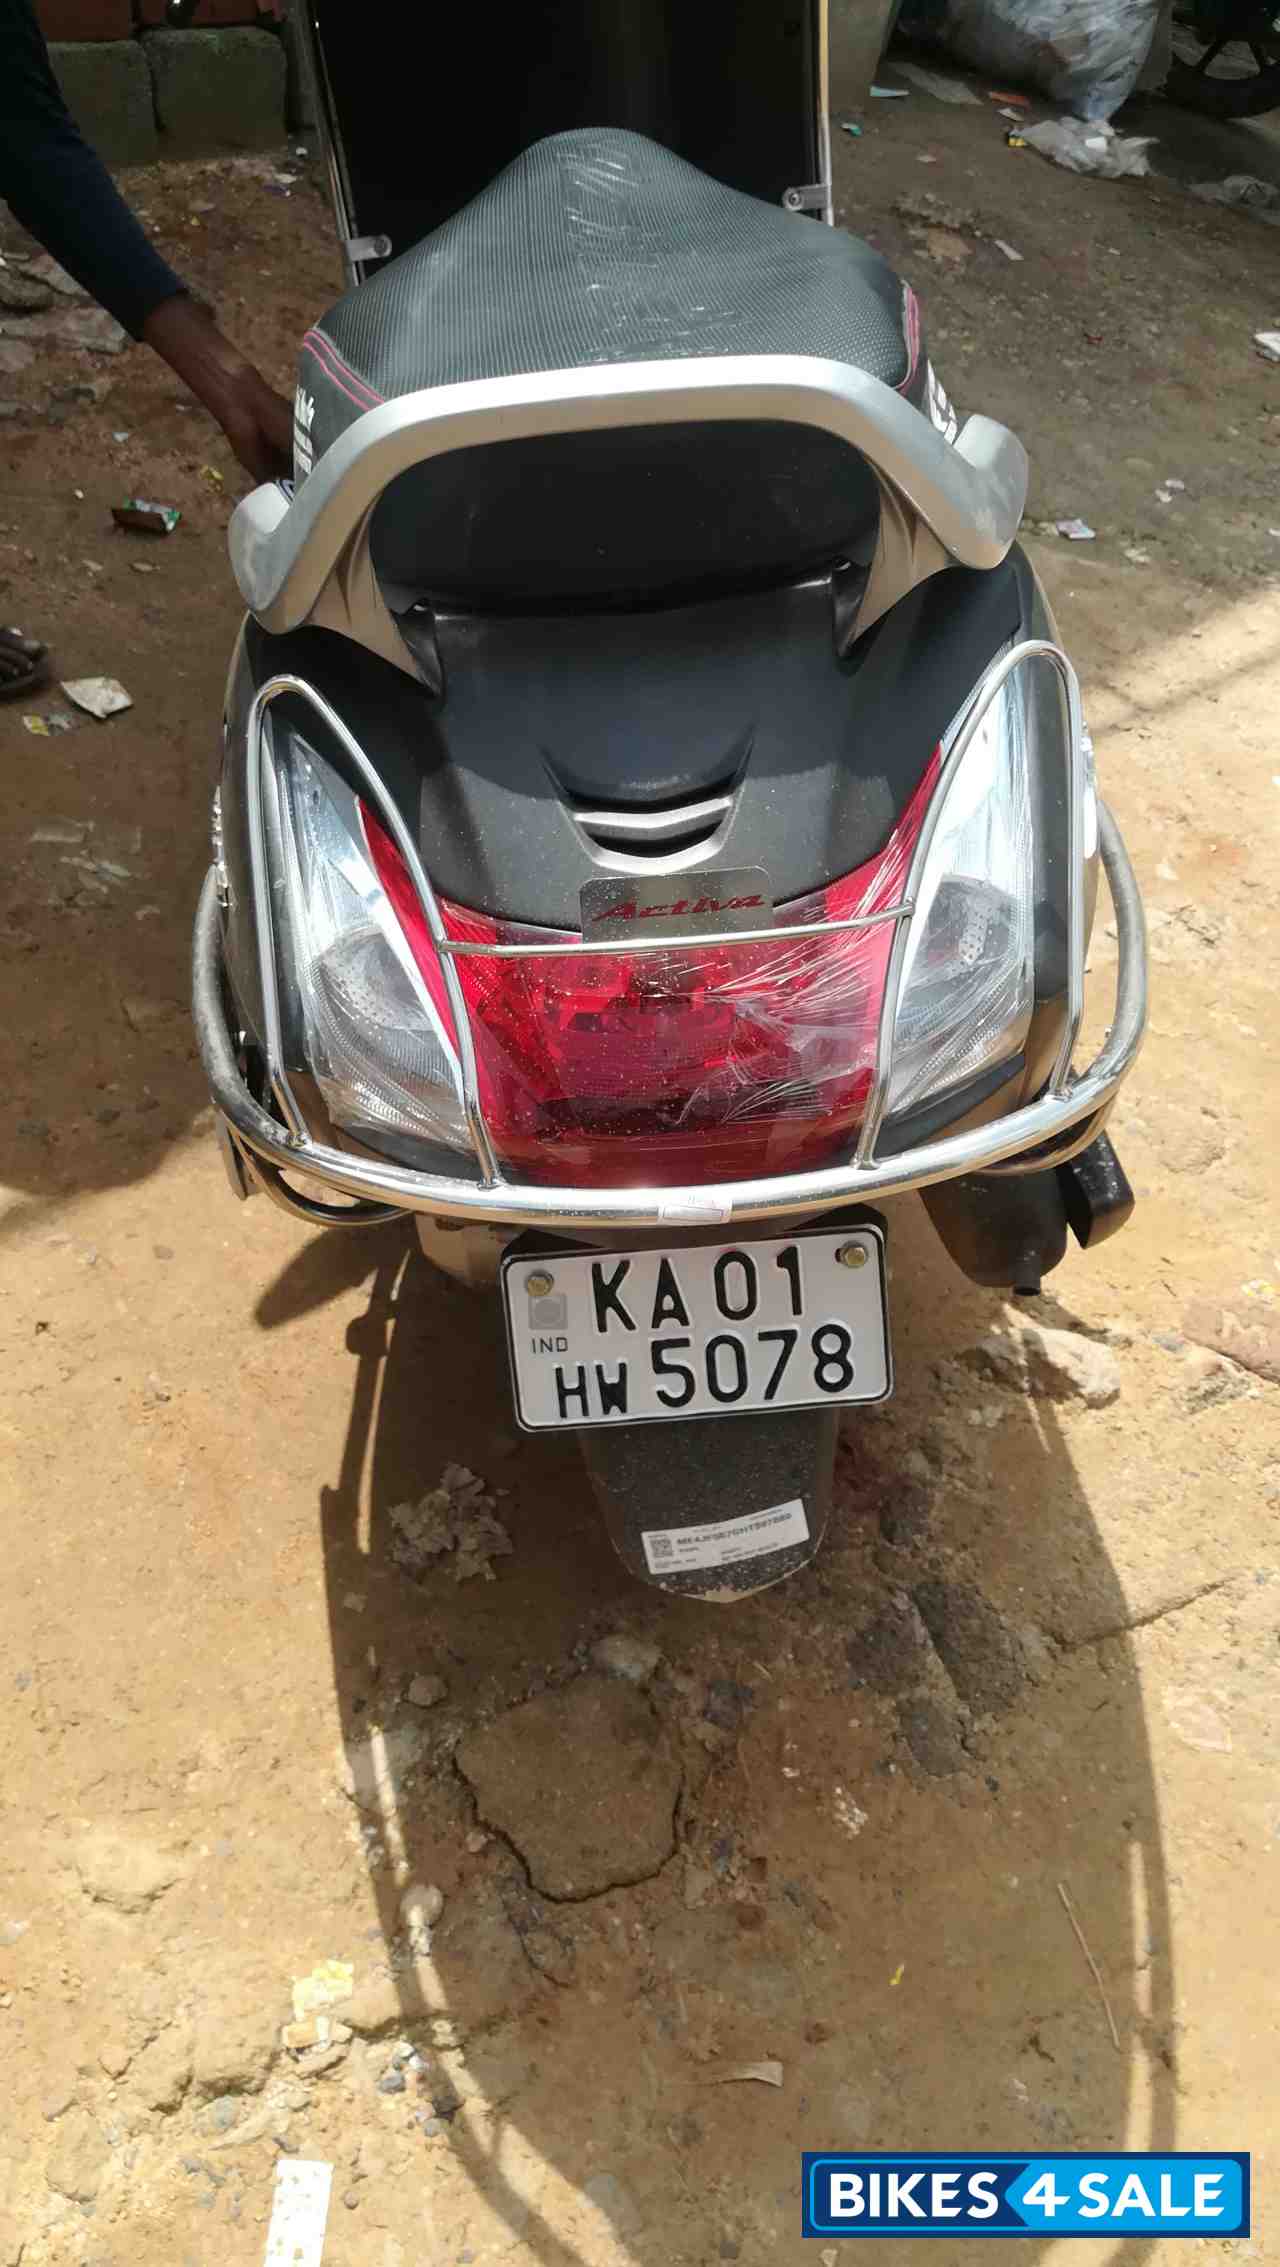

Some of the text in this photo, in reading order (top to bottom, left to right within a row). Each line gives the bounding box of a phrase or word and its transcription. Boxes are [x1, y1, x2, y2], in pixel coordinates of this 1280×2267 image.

[592, 894, 765, 922] Activa
[591, 1245, 803, 1334] KA 01
[531, 1336, 569, 1355] IND
[554, 1323, 854, 1419] HW 5078
